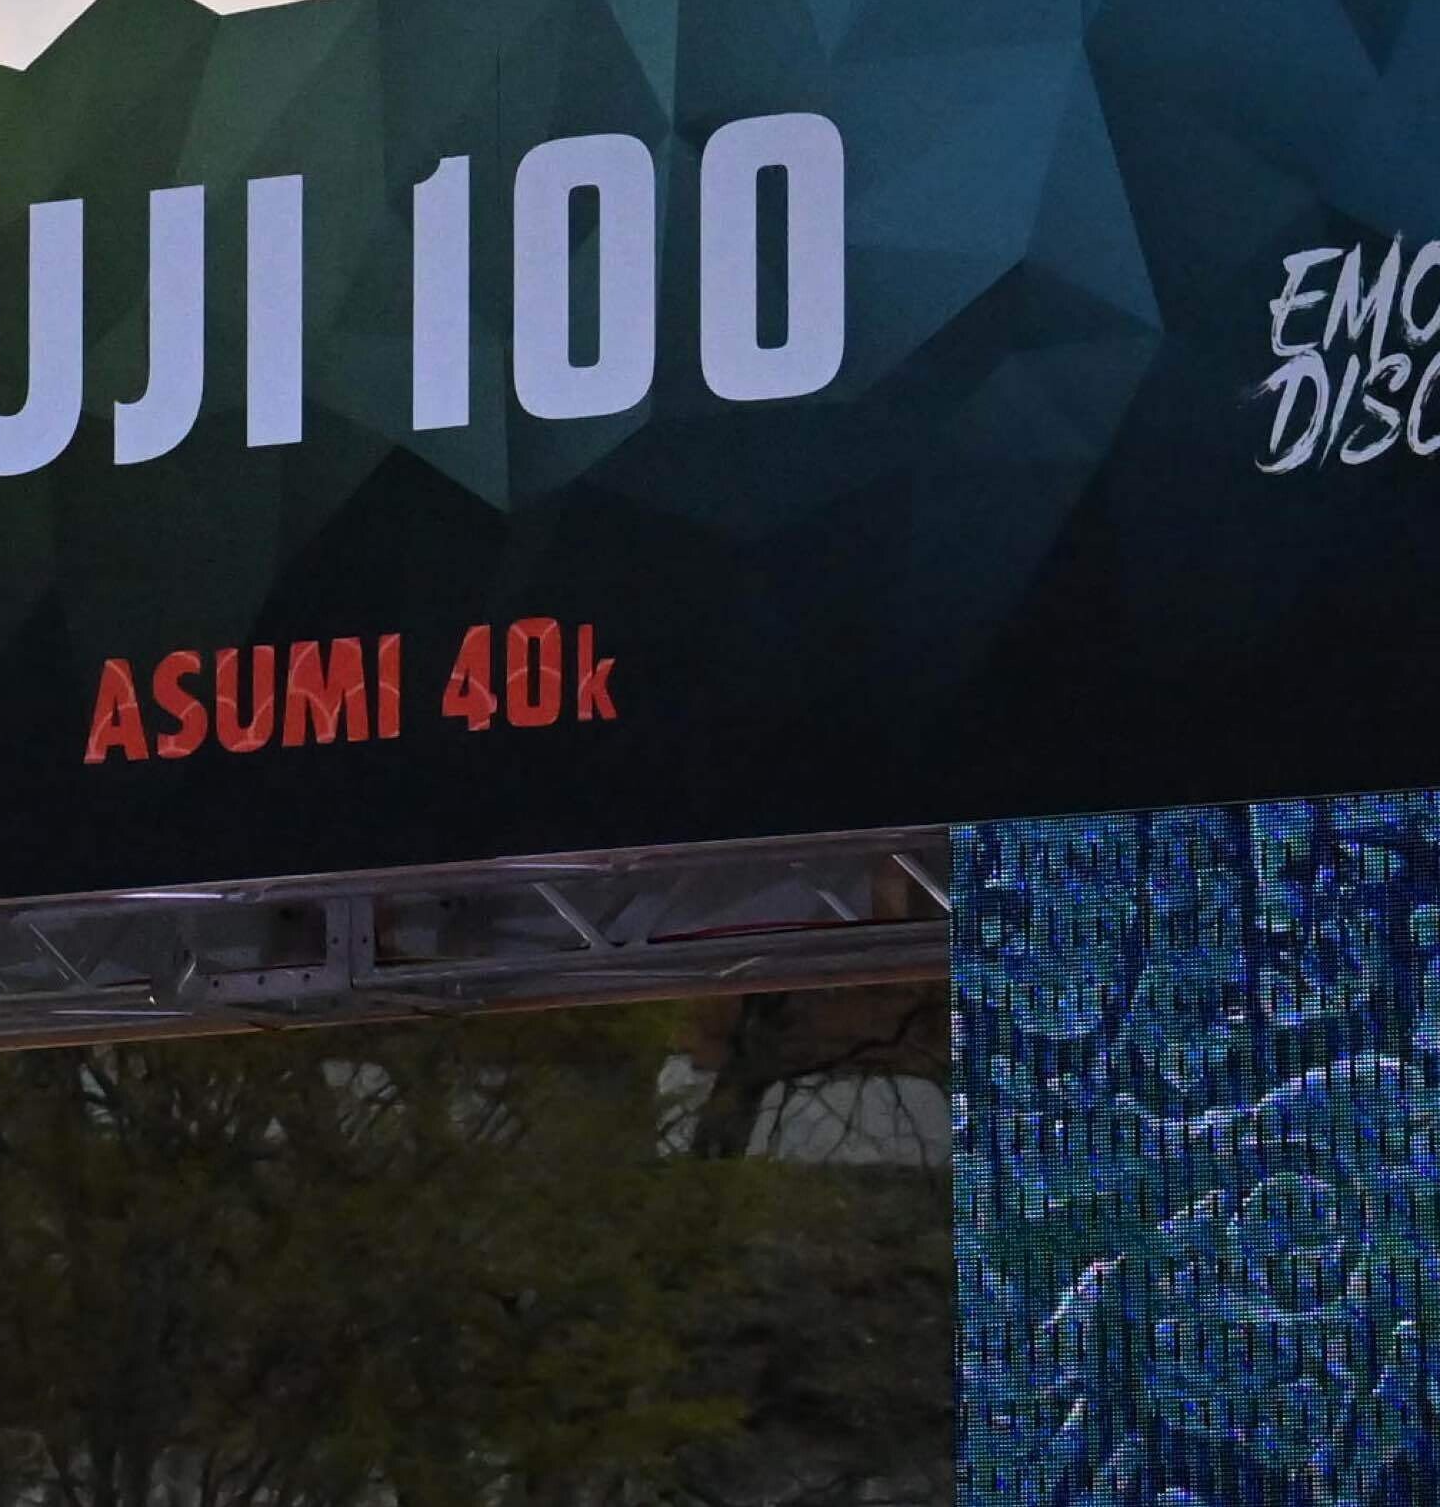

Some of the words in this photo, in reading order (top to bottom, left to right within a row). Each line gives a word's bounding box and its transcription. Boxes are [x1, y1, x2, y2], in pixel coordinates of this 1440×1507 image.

[412, 113, 846, 430] 100
[84, 633, 402, 765] ASUMI
[441, 616, 617, 731] 40k
